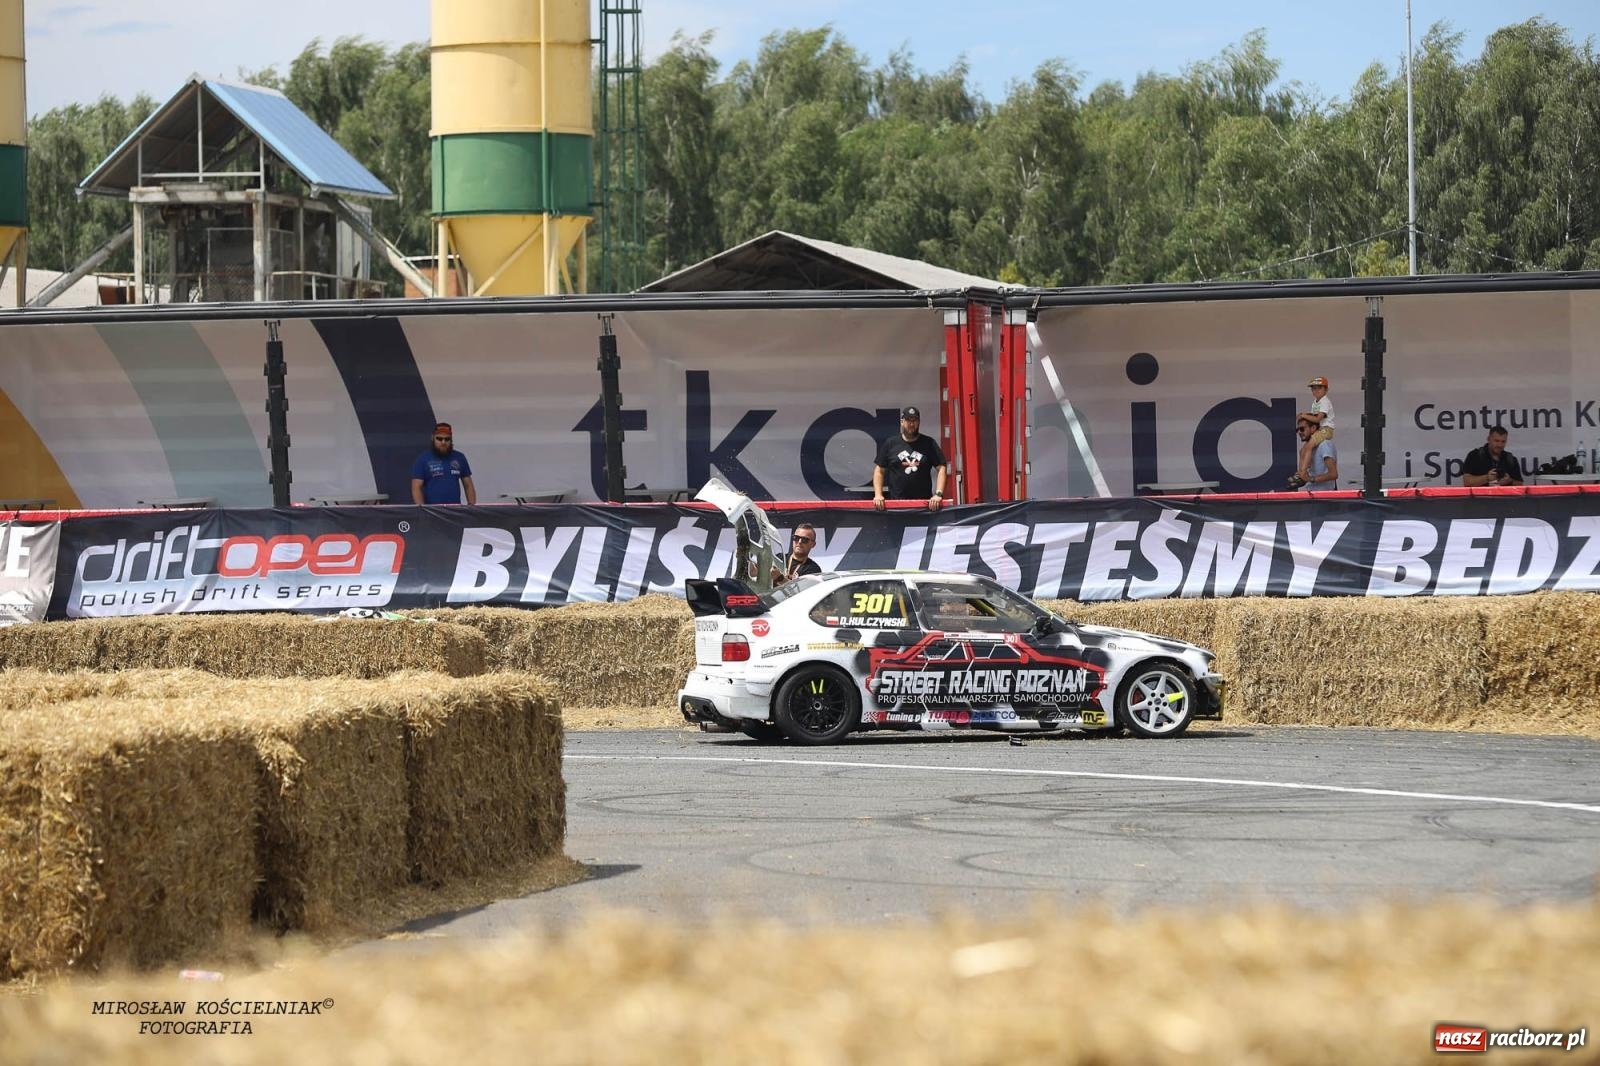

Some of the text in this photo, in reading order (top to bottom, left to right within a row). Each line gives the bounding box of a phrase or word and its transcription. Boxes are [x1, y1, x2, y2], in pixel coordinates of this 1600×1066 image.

[1414, 400, 1600, 430] Centrum K
[1405, 452, 1411, 477] i
[80, 583, 382, 609] polish drift series
[850, 593, 894, 614] 301
[880, 670, 945, 694] STREET
[948, 669, 1011, 694] RACING
[878, 693, 1091, 704] PROFESJONALNY WARSZTAT SAMOCHODOWY
